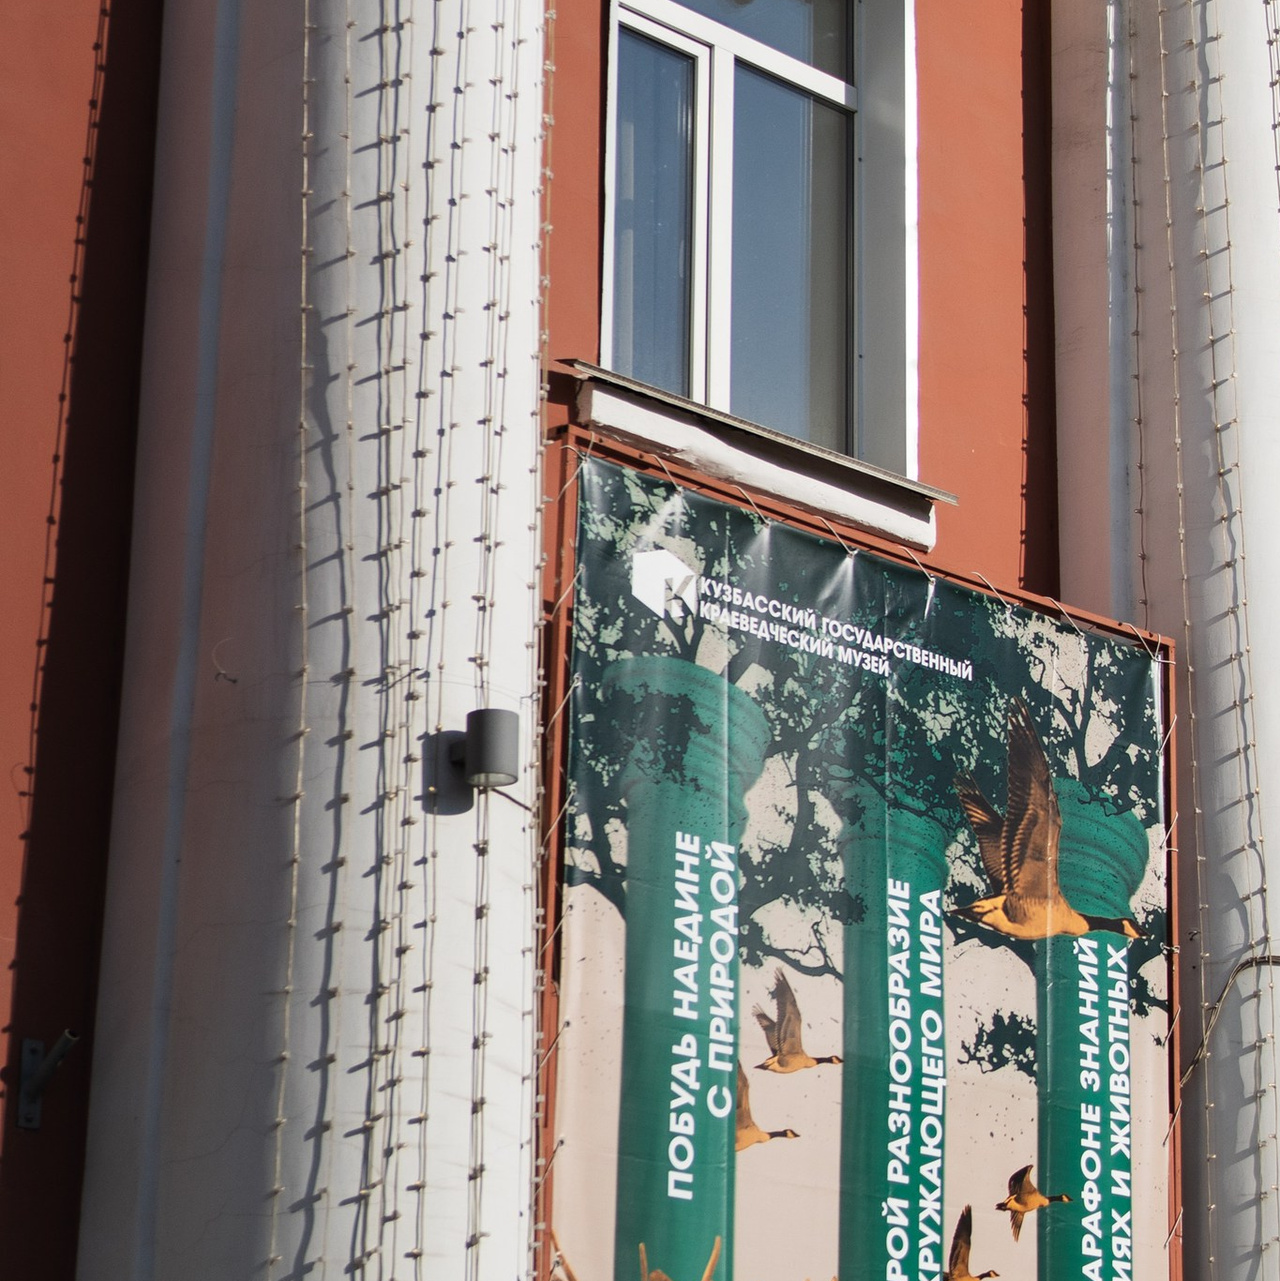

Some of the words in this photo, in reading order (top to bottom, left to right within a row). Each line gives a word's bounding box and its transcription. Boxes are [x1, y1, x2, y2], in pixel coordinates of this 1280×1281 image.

[700, 576, 816, 630] КУЗБАССКИЙ
[822, 617, 973, 681] ГОСУДАРСТВЕННЫЙ
[700, 600, 833, 659] КРАЕВЕДЧЕСКИЙ
[838, 645, 890, 677] МУЗЕЙ
[673, 830, 704, 1020] НАЕДИНЕ
[705, 841, 740, 1072] ПРИРОДОЙ
[919, 889, 942, 997] МИРА
[886, 877, 912, 1185] РАЗНООБРАЗИЕ
[1073, 937, 1101, 1092] ЗНАНИЙ
[1107, 944, 1132, 1159] ЖИВОТНЫХ
[667, 1034, 703, 1200] ПОБУДЬ
[707, 1083, 733, 1118] С
[1110, 1171, 1131, 1198] И
